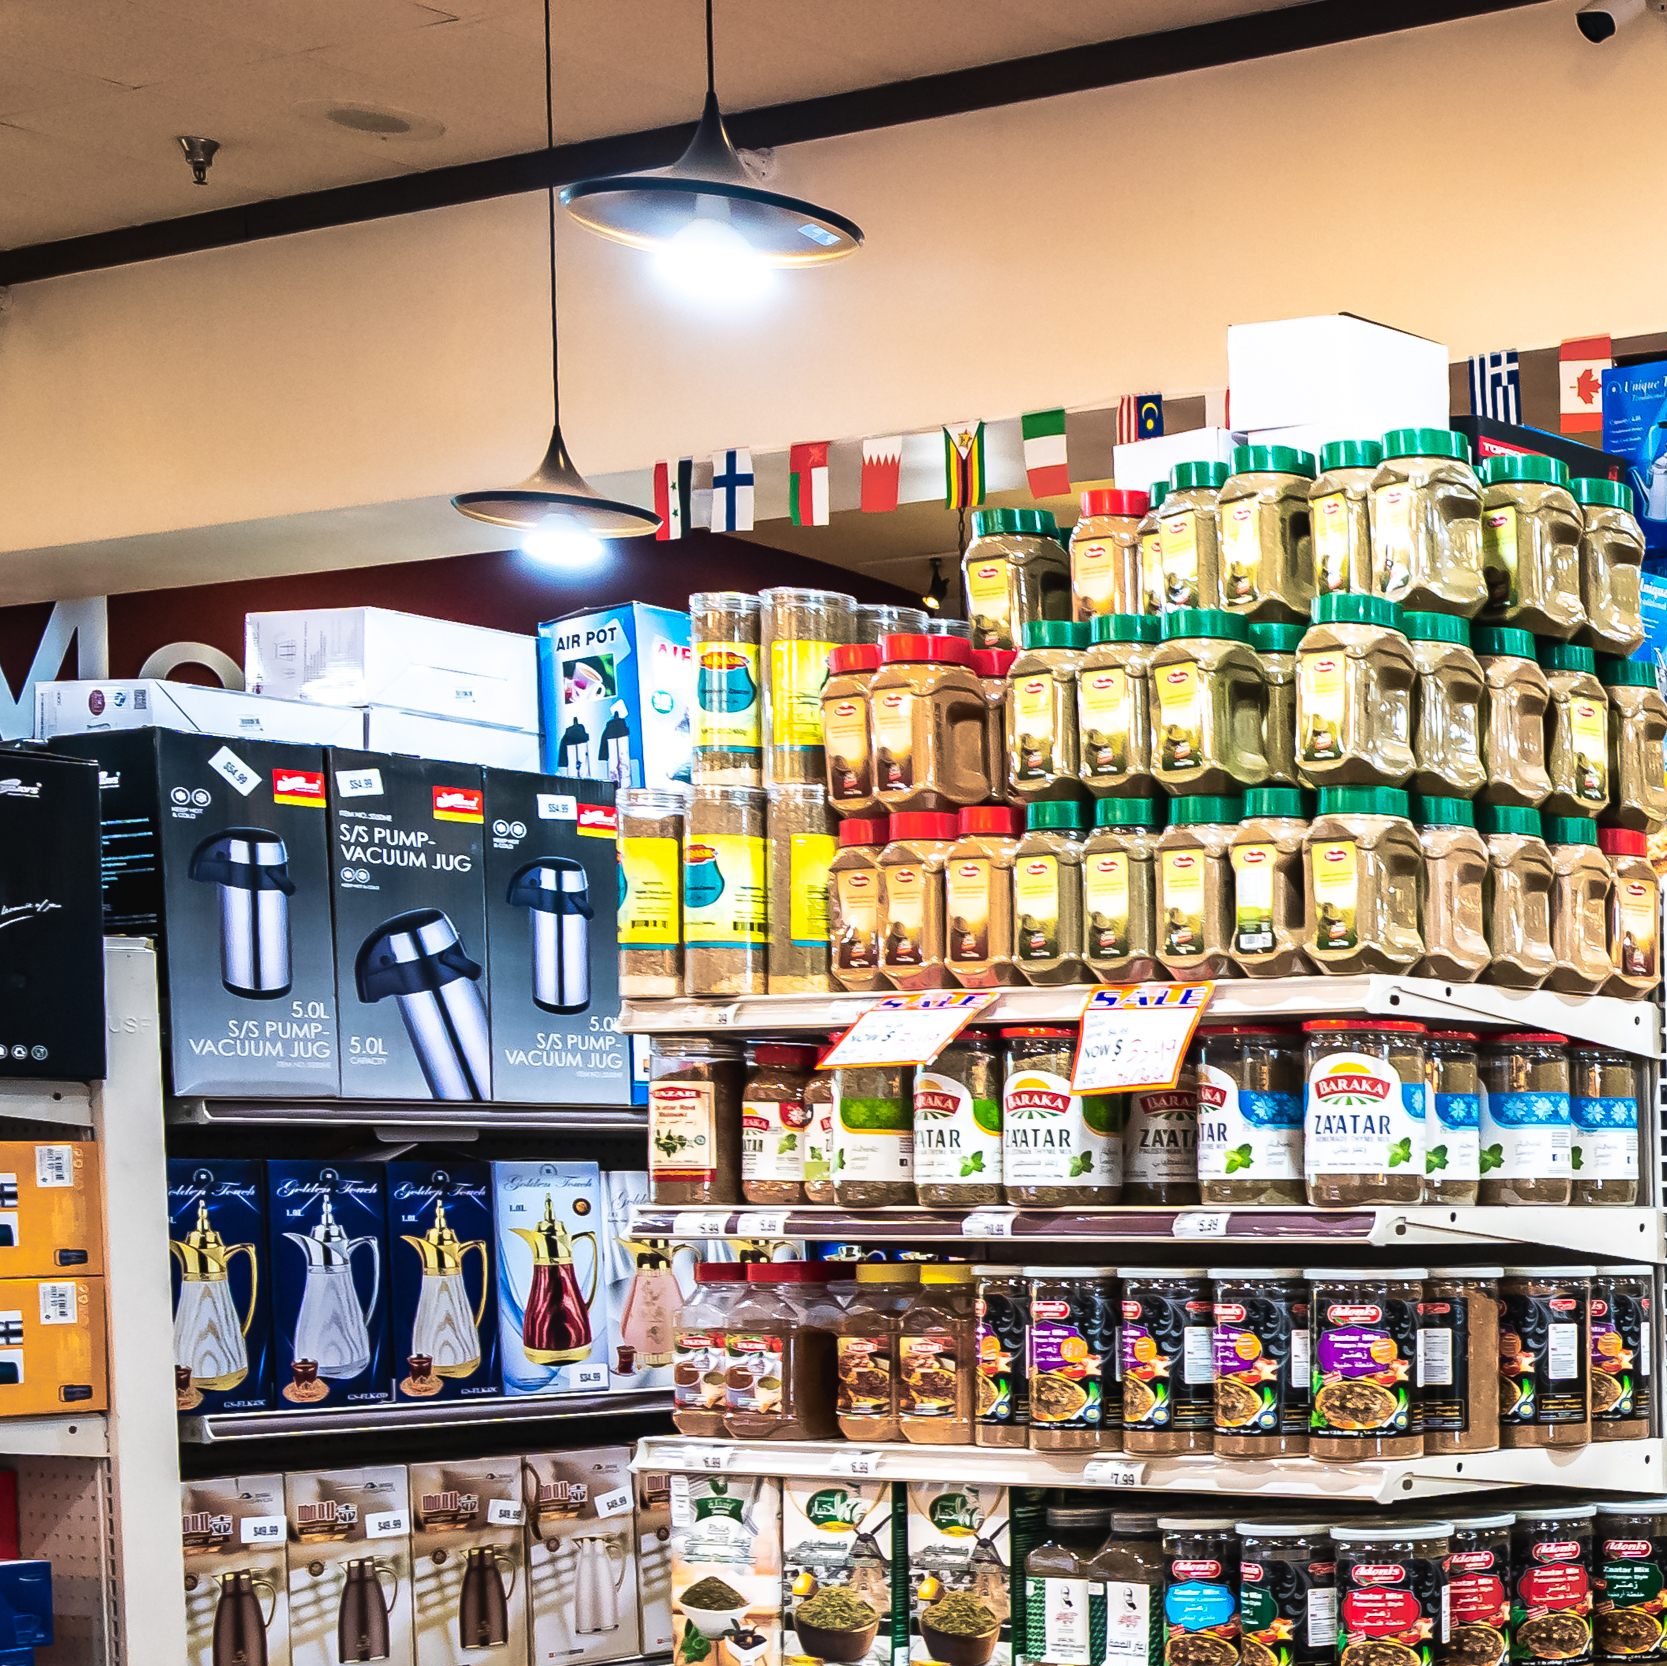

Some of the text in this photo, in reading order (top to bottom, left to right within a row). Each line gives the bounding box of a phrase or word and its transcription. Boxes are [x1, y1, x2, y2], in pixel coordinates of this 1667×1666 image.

[1624, 379, 1660, 394] Unique
[555, 626, 617, 653] AIR POT
[339, 824, 436, 849] S/S PUMP-
[341, 846, 472, 872] VACUUM JUG
[1094, 987, 1208, 1008] SALE
[292, 1002, 330, 1019] 5.0L
[228, 1020, 330, 1039] S/S PUMP-
[189, 1038, 331, 1058] VACUUM JUG
[350, 1037, 388, 1054] 5.0L
[536, 1032, 622, 1050] S/S PUMP-
[1084, 1039, 1123, 1059] NOW $
[505, 1050, 623, 1069] VACUUM JUG
[1315, 1076, 1390, 1098] BARAKA
[1006, 1094, 1066, 1111] BARAKA
[211, 1183, 255, 1198] Touch
[277, 1179, 377, 1199] Golden Touch
[395, 1183, 486, 1199] Golden Touch
[503, 1176, 593, 1191] Golden Touch
[1534, 1543, 1578, 1557] Adonis
[1605, 1541, 1648, 1555] Adonis
[1352, 1564, 1401, 1579] Adonis
